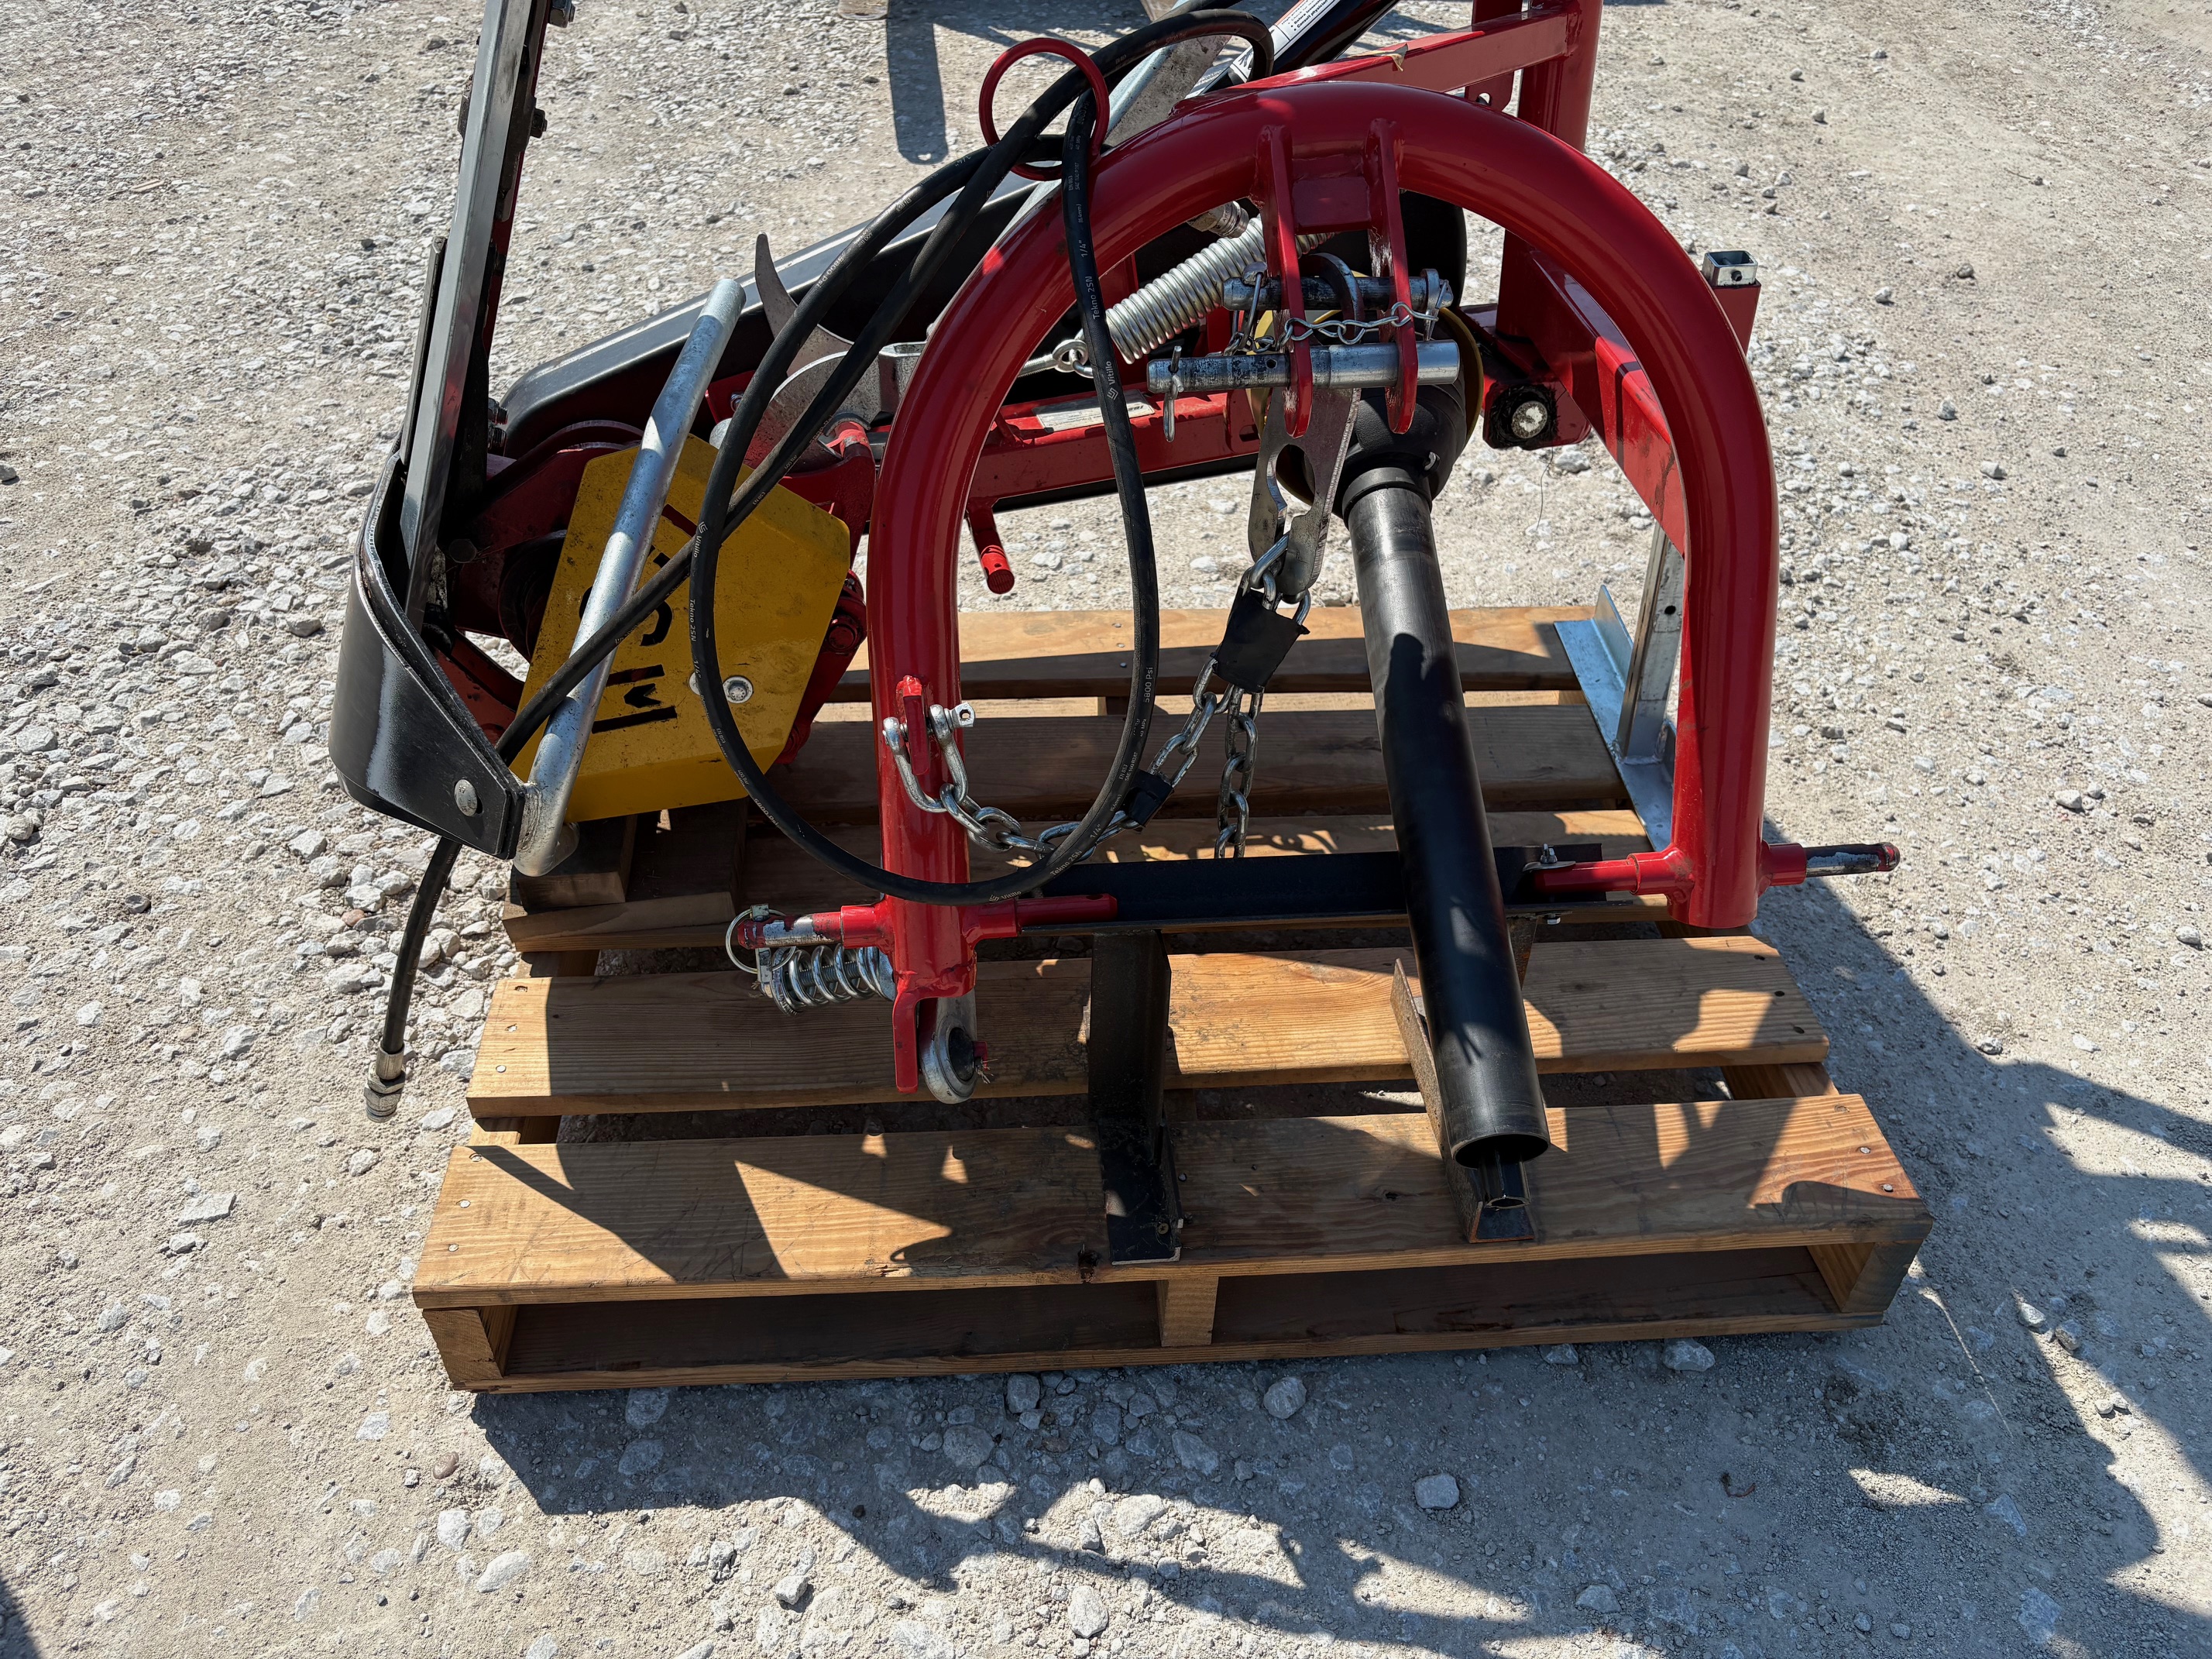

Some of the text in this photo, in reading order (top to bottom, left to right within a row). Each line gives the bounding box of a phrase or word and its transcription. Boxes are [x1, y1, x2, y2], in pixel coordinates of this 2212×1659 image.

[1297, 15, 1311, 28] Consult
[1084, 275, 1101, 320] Tekno 2SN
[1105, 360, 1117, 386] Vitillo
[692, 534, 702, 558] Vitillo
[1143, 681, 1153, 704] 5800
[1118, 771, 1126, 780] EN
[1124, 771, 1132, 782] SAE
[1049, 849, 1083, 878] Tekno 2SN
[1001, 890, 1022, 902] Vitillo
